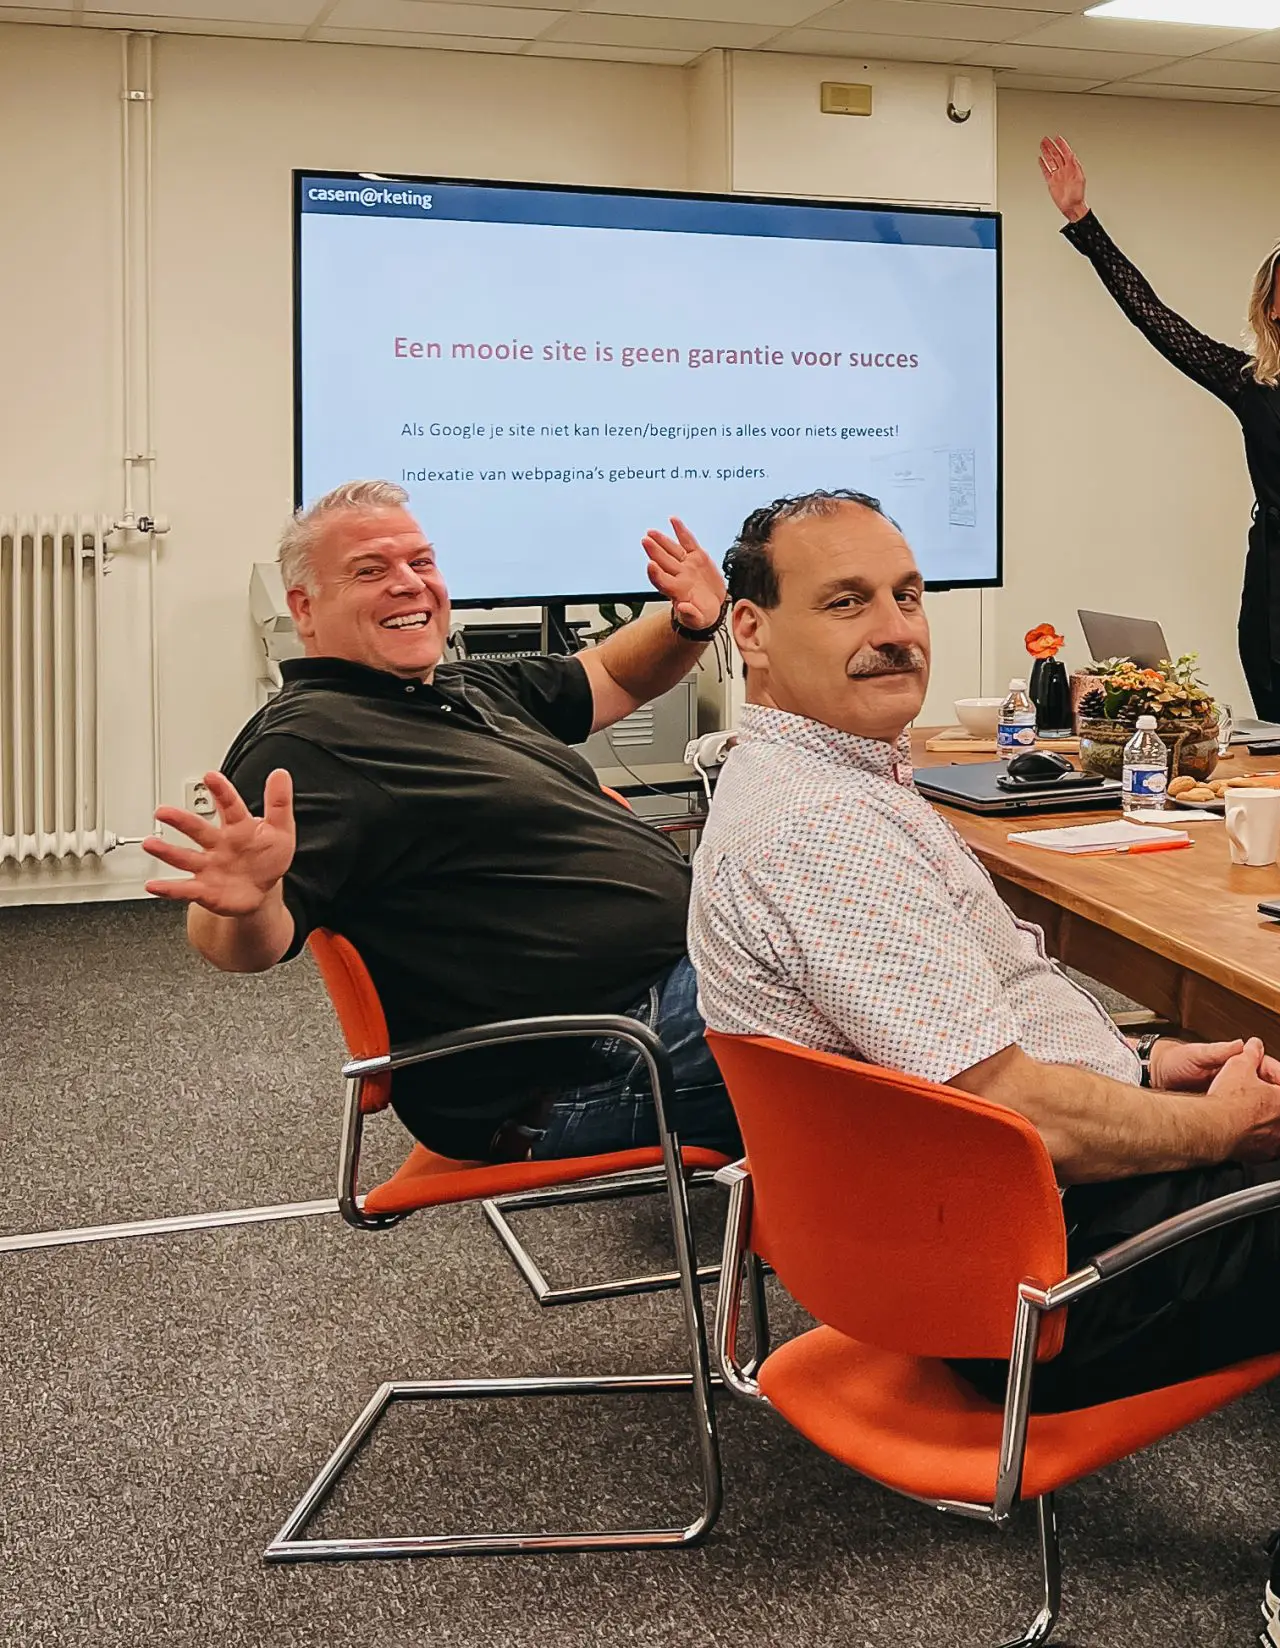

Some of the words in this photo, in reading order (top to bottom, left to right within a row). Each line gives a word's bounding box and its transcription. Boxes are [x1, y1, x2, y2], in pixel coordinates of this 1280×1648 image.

[308, 186, 433, 209] casem@rketing
[394, 336, 442, 358] Een
[452, 338, 534, 360] mooie
[542, 340, 587, 361] site
[595, 341, 614, 362] is
[621, 346, 680, 367] geen
[687, 345, 785, 368] garantie
[790, 350, 843, 367] voor
[849, 352, 919, 368] succes
[401, 422, 425, 437] Als
[429, 422, 486, 440] Google
[489, 423, 504, 440] je
[509, 423, 536, 437] site
[540, 423, 570, 437] niet
[574, 422, 600, 437] kan
[604, 422, 717, 440] lezen/begrijpen
[721, 423, 733, 437] is
[735, 423, 767, 437] alles
[770, 426, 802, 437] voor
[805, 424, 838, 437] niets
[840, 423, 899, 440] geweest!
[401, 467, 475, 482] Indexatie
[479, 470, 507, 482] van
[608, 465, 667, 483] gebeurt
[670, 465, 712, 480] d.m.v.
[716, 464, 769, 482] spiders.
